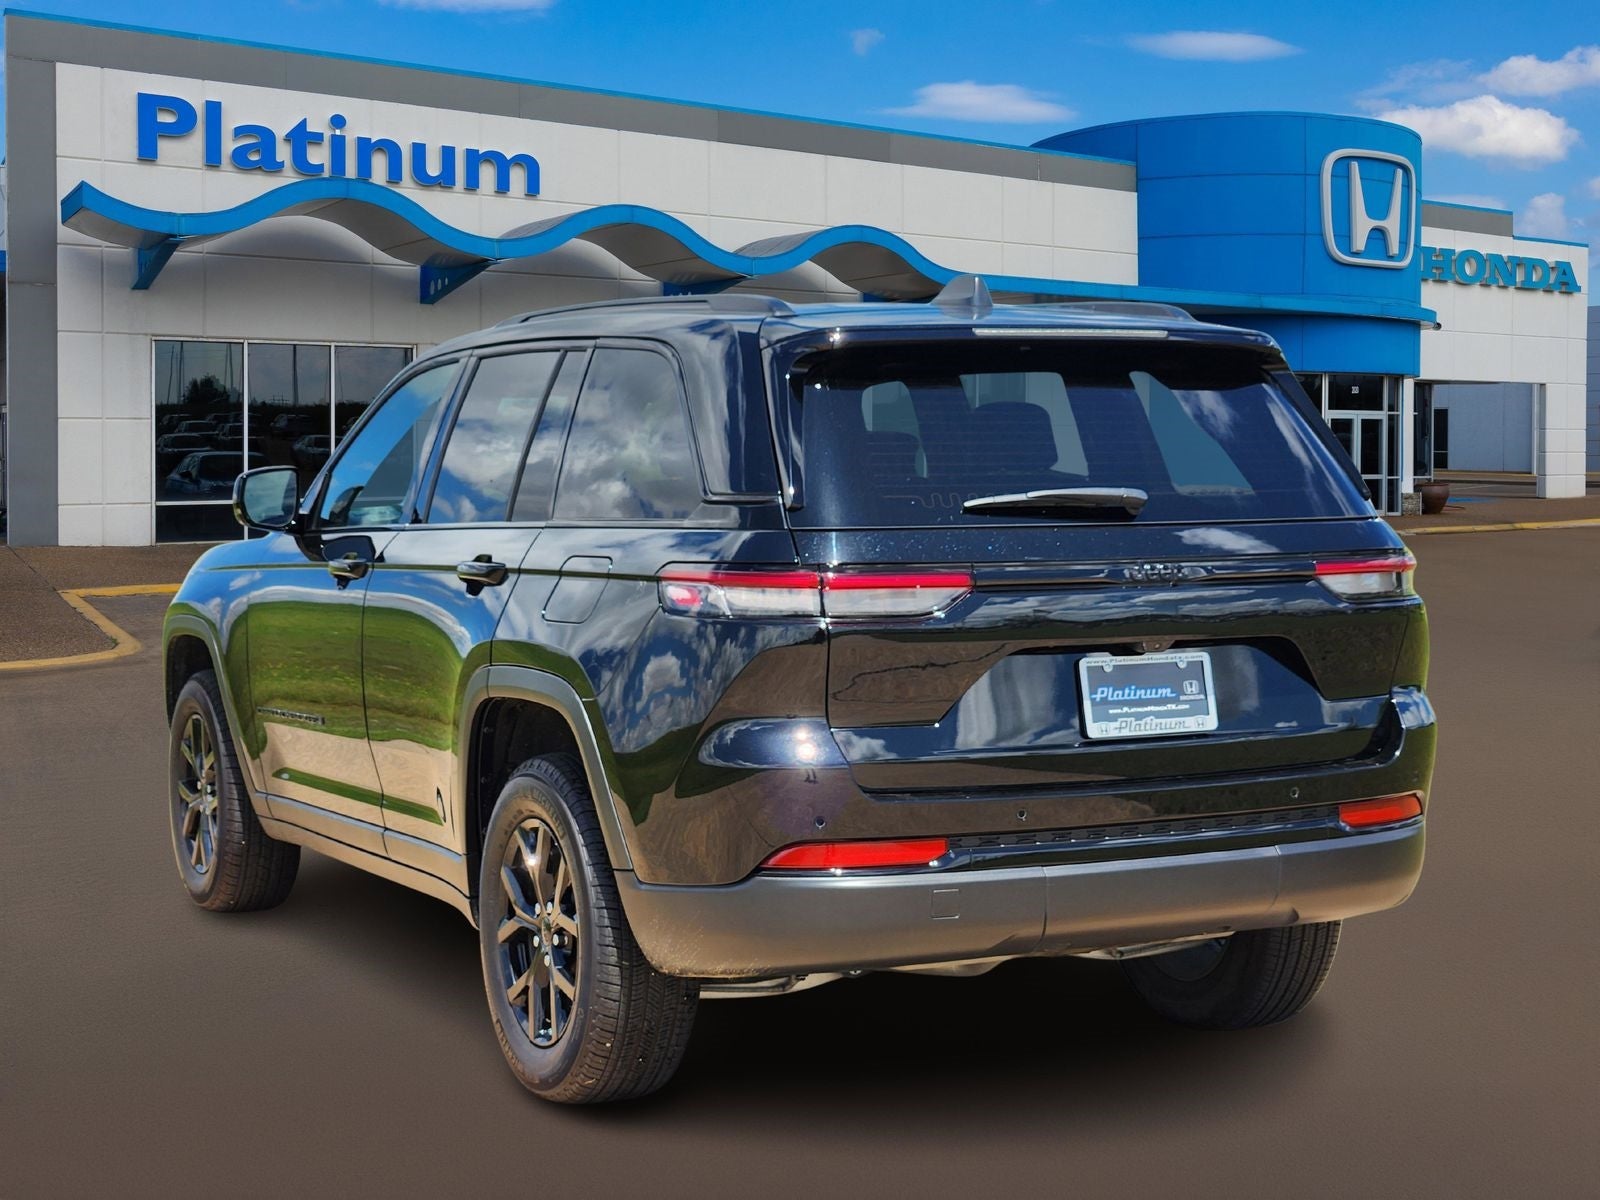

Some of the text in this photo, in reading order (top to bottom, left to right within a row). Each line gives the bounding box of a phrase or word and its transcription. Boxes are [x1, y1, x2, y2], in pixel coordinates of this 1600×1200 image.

[136, 92, 541, 197] Platinum
[1420, 246, 1582, 293] HONDA
[1091, 685, 1177, 701] Platinum
[1112, 718, 1192, 733] Platinum
